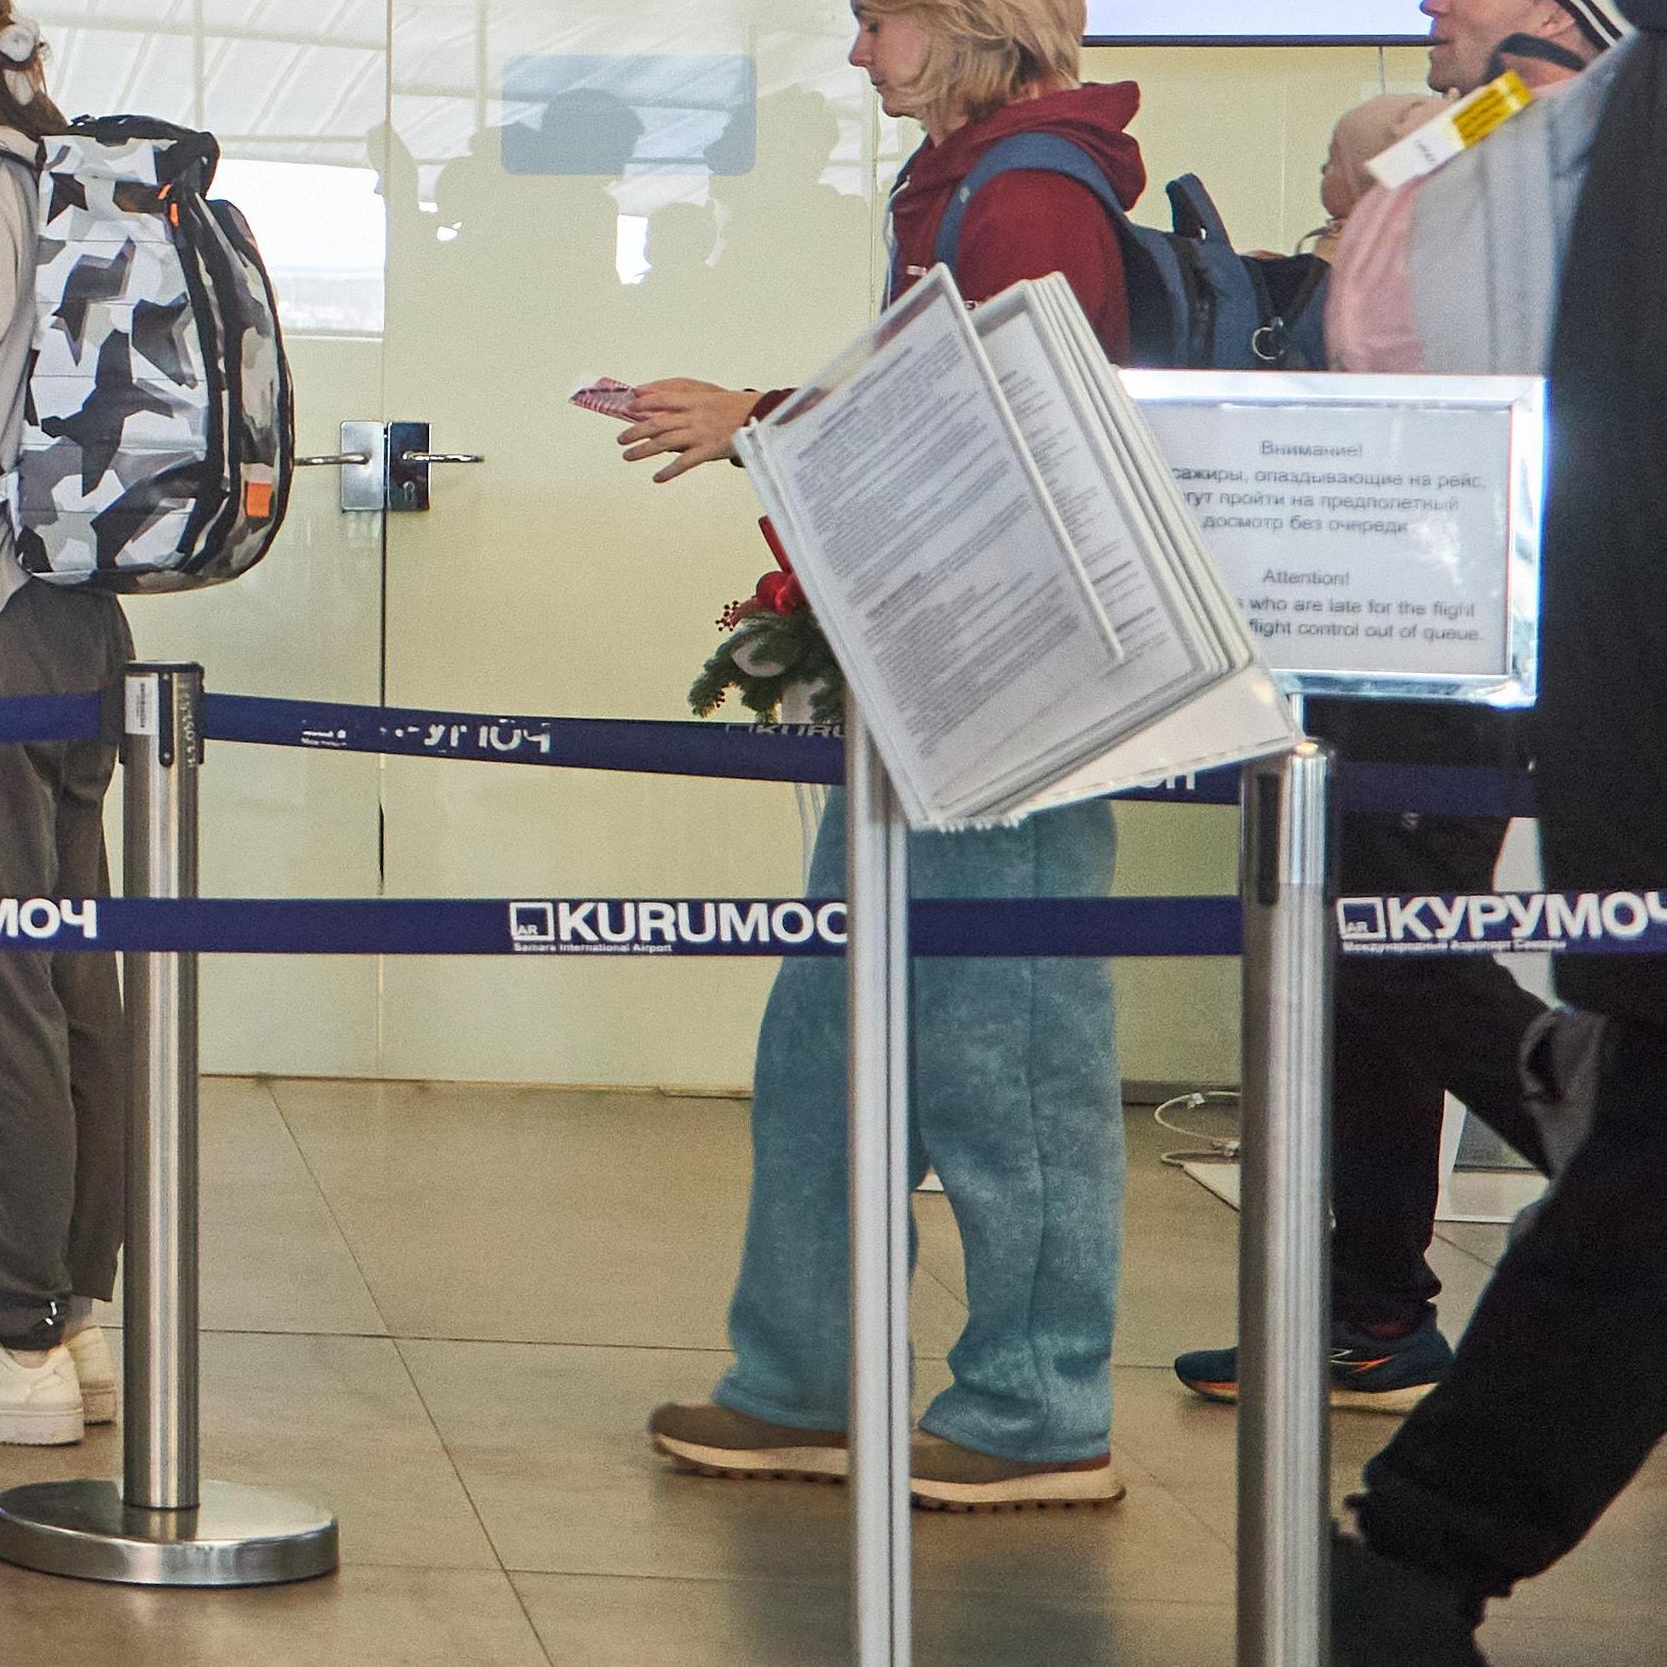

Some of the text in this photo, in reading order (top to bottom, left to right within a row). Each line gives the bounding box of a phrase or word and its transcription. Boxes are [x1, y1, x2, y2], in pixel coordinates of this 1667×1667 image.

[1259, 440, 1364, 457] Внимание!
[1171, 467, 1249, 490] сажиры,
[1263, 568, 1350, 587] Attention!
[1250, 595, 1288, 612] who
[1294, 599, 1323, 613] are
[1399, 599, 1426, 616] the
[559, 901, 848, 943] KURUMOC
[514, 942, 672, 954] Samara International Airport
